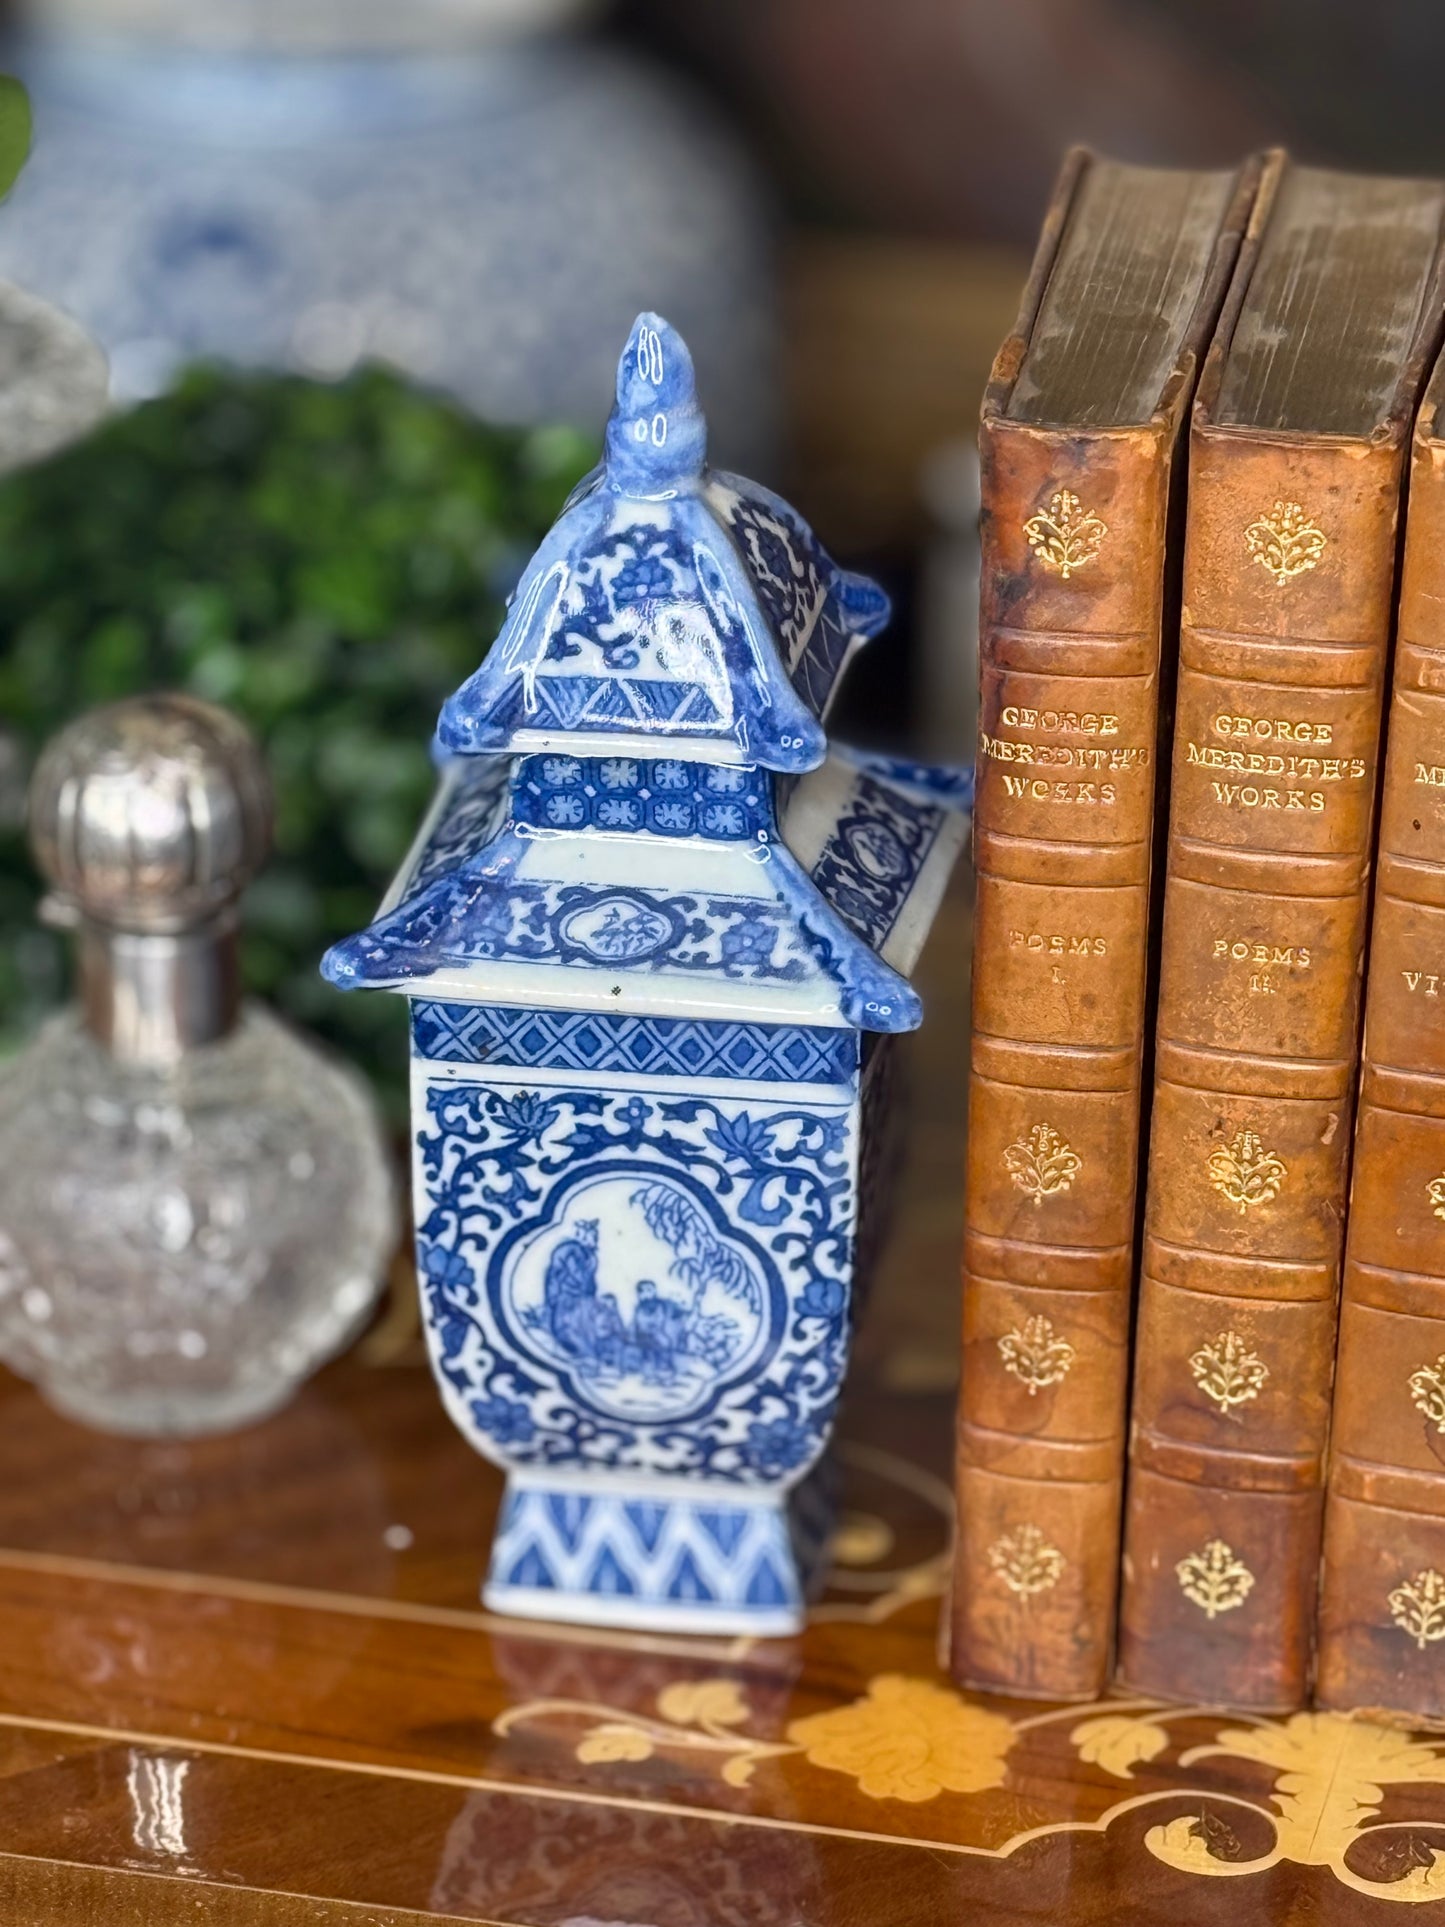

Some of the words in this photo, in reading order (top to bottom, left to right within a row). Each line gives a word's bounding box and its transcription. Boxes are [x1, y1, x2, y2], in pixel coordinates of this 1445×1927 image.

[1002, 706, 1120, 737] GEORGE
[1215, 714, 1334, 745] GEORGE
[1186, 741, 1366, 782] MEREDITH'S
[1211, 781, 1326, 812] WORKS
[1009, 930, 1107, 957] POEMS
[1212, 940, 1312, 968] POEMS
